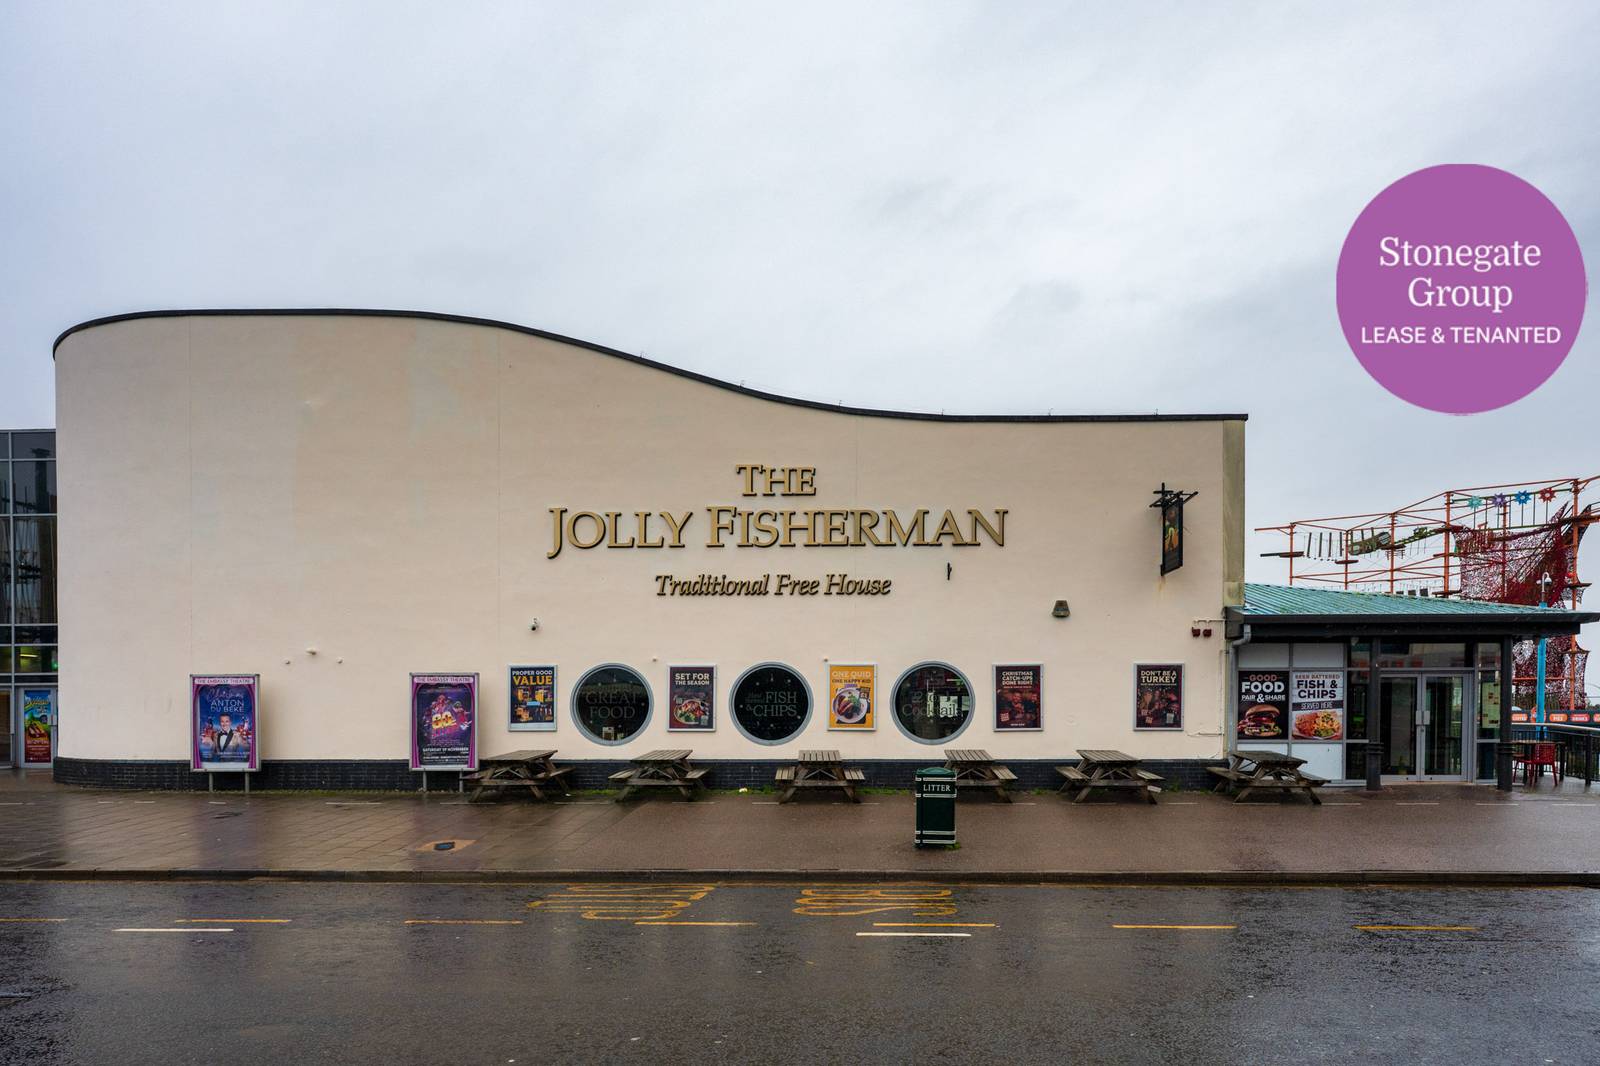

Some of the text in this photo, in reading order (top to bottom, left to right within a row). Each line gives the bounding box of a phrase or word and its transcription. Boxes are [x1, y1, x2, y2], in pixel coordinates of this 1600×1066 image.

[735, 463, 817, 496] THE
[546, 505, 1009, 559] JOLLY FISHERMAN
[655, 574, 892, 596] Traditional Free House
[513, 675, 552, 685] VALUE
[1296, 679, 1338, 689] FISH &
[1241, 681, 1285, 693] FOOD
[585, 690, 640, 704] GREAT
[765, 691, 798, 704] FISH
[1256, 693, 1265, 703] &
[1297, 689, 1337, 699] CHIPS
[752, 704, 798, 717] CHIPS
[1300, 702, 1319, 710] SERVED
[589, 706, 636, 719] FOOD
[923, 784, 951, 792] LITTER
